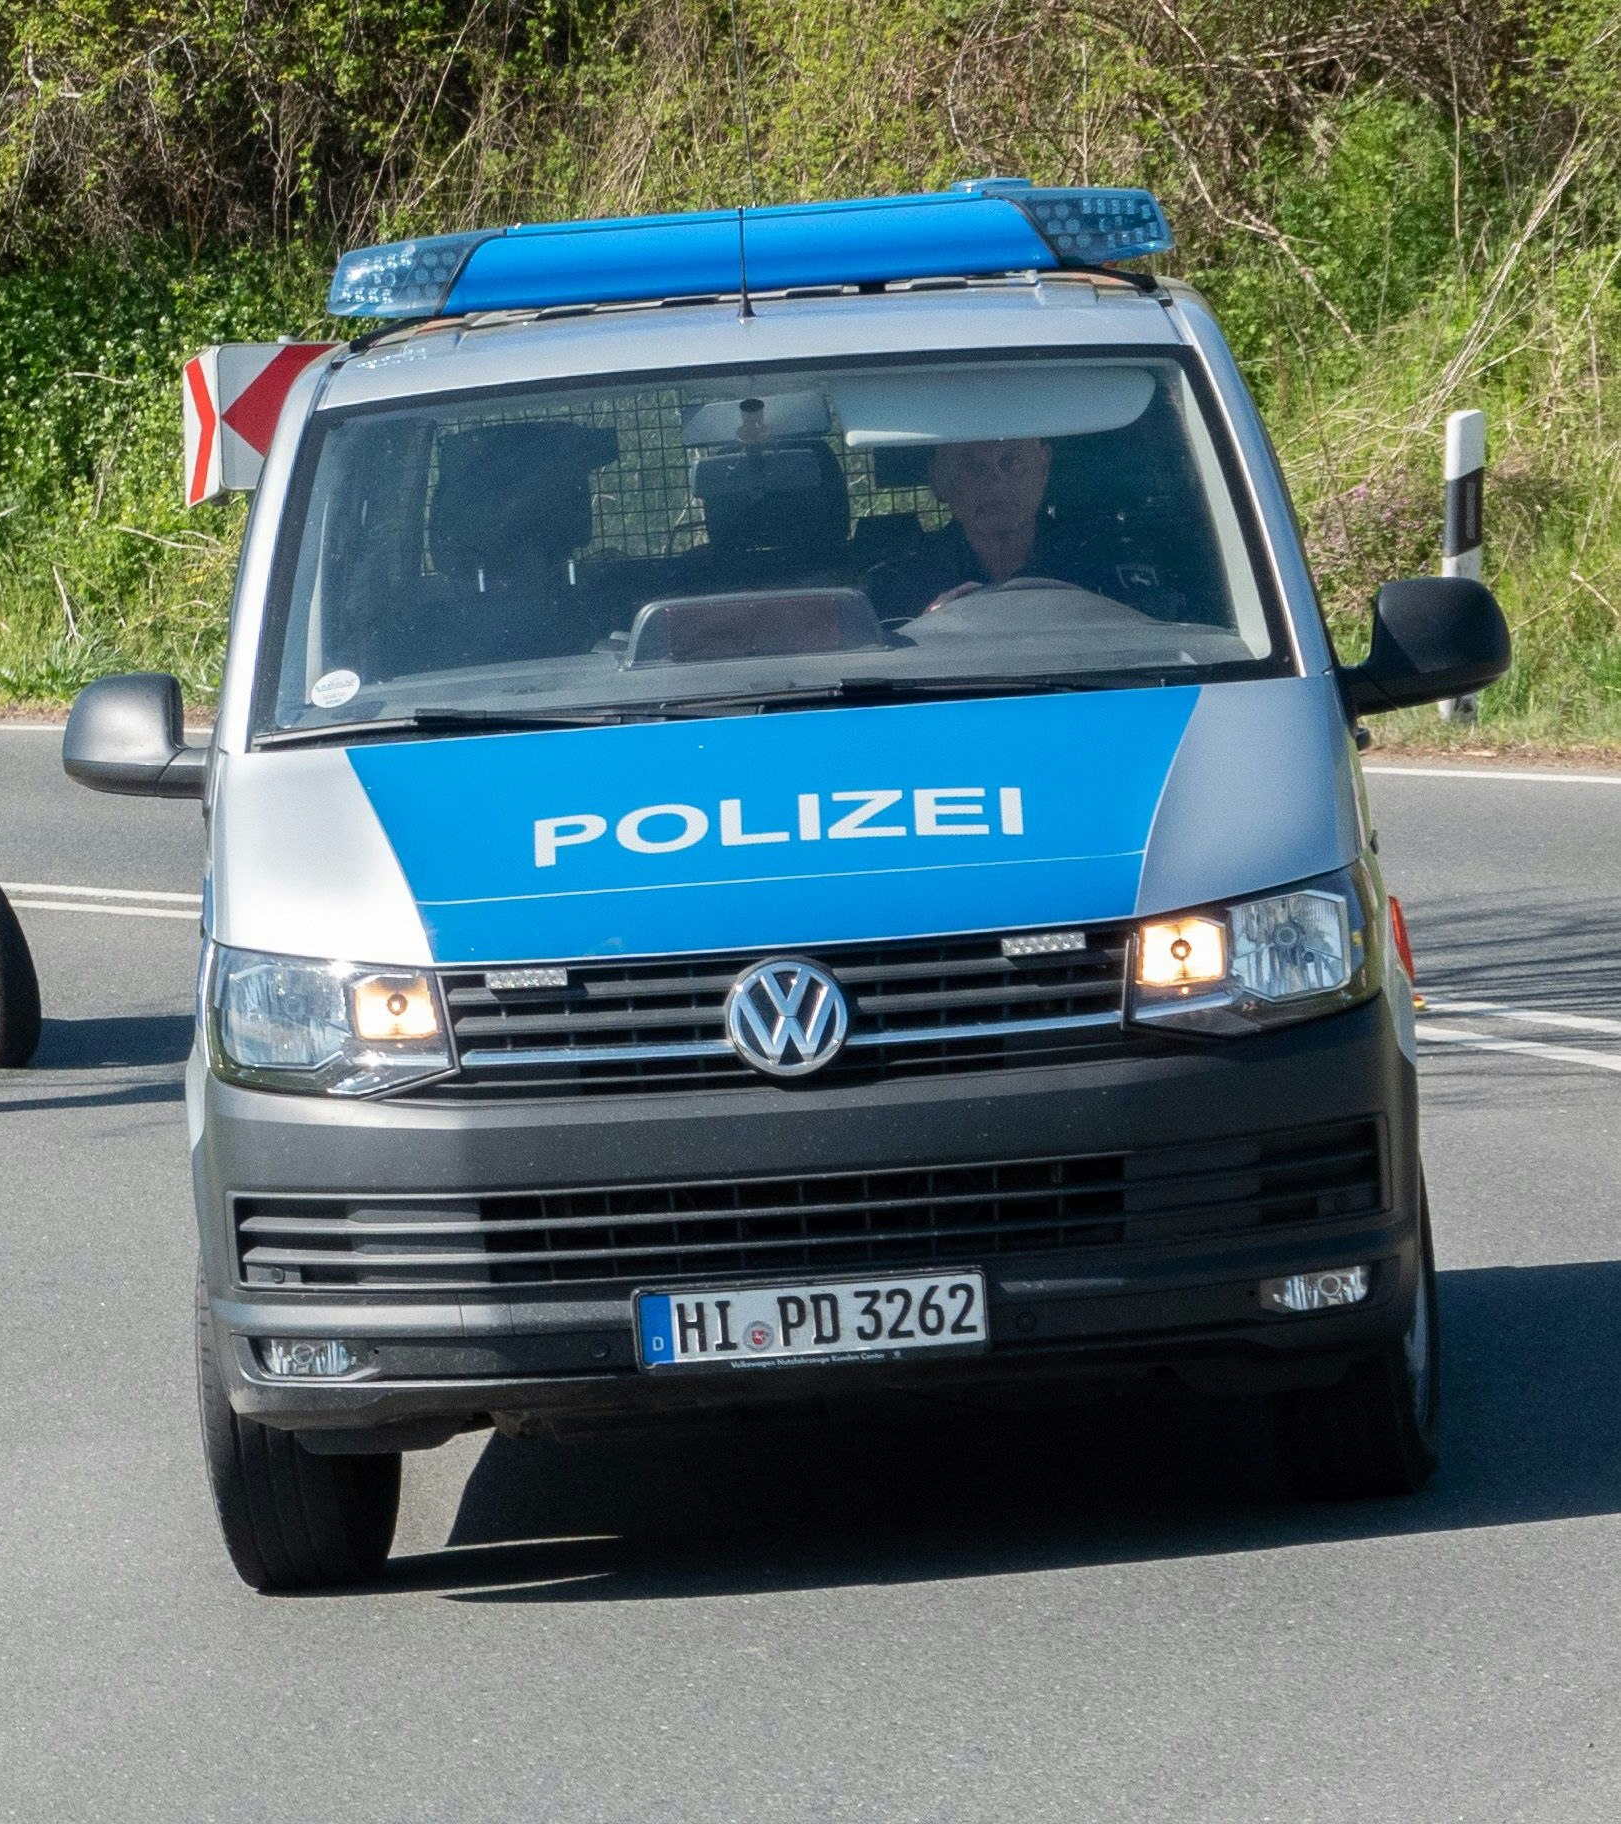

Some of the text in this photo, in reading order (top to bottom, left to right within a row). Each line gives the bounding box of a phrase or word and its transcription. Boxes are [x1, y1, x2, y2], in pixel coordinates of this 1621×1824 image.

[534, 787, 1024, 868] POLIZEI
[730, 960, 848, 1077] VW
[652, 1336, 664, 1351] D
[675, 1283, 978, 1354] HI PD 3262
